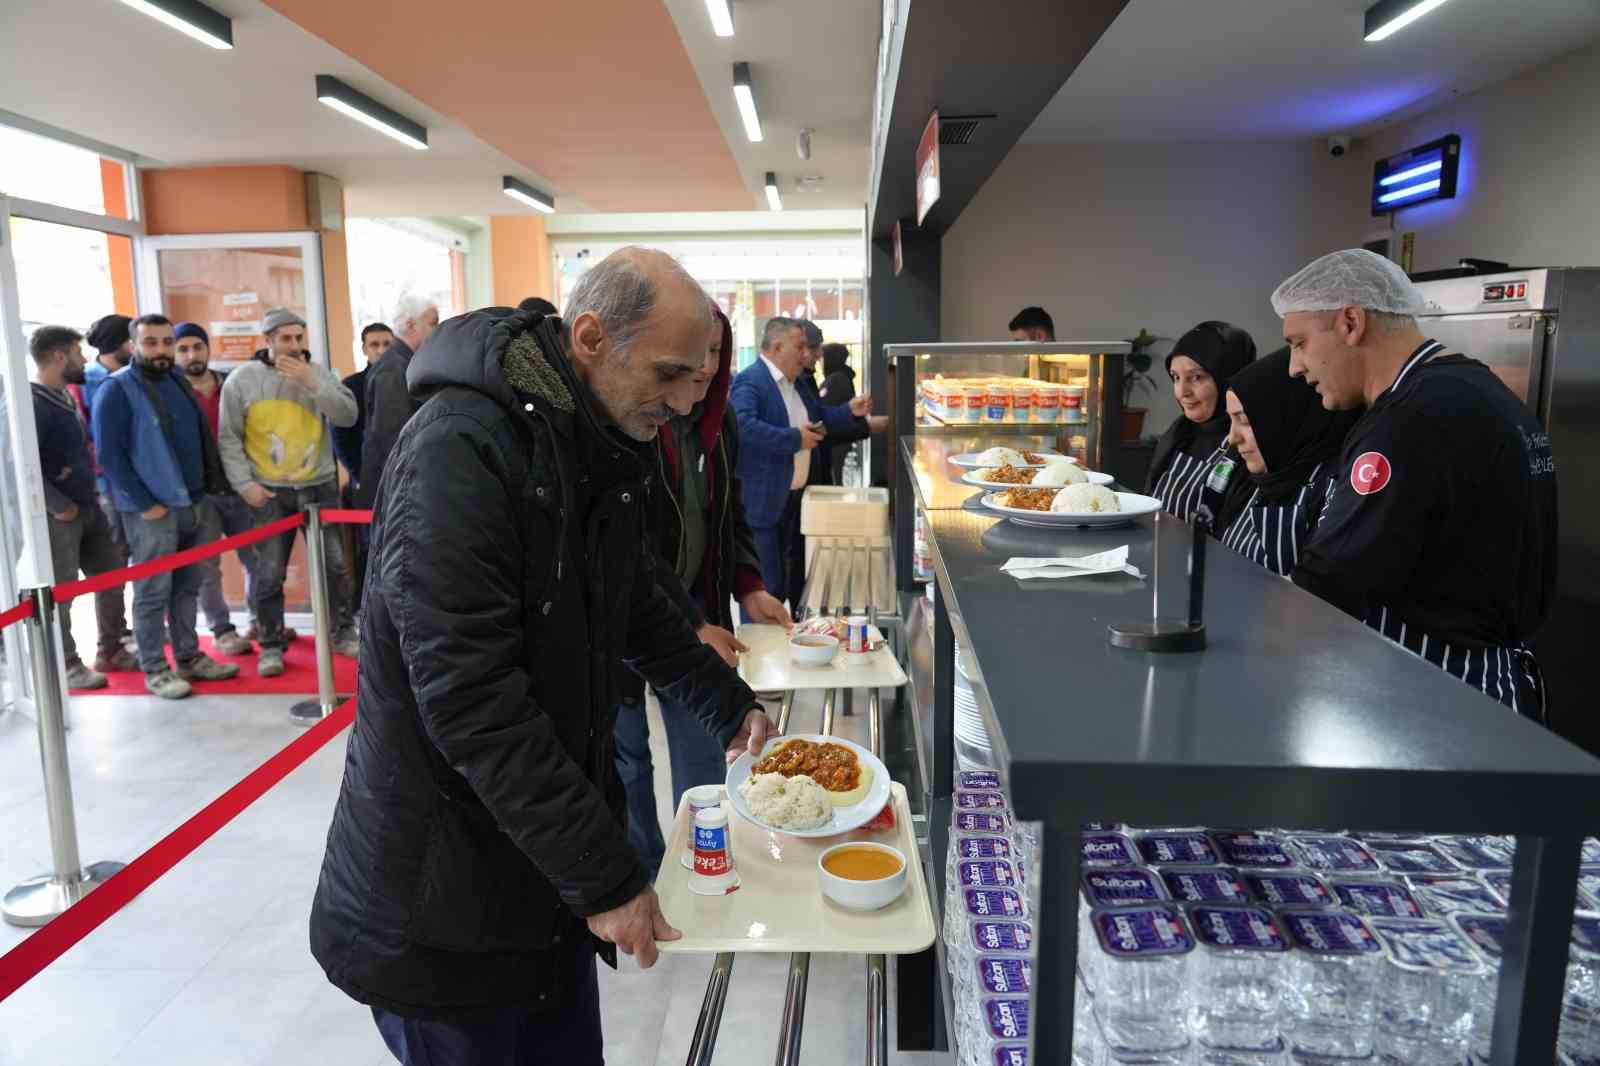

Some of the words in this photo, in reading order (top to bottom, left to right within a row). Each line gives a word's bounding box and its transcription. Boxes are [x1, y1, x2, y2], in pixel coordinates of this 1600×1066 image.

[970, 864, 982, 886] Sultan
[1091, 877, 1147, 888] Sultan
[976, 893, 989, 915] Sultan
[986, 925, 1000, 948] Sultan
[1114, 916, 1139, 950] Sultan
[992, 961, 1009, 992] Sultan
[998, 1002, 1018, 1038] Sultan
